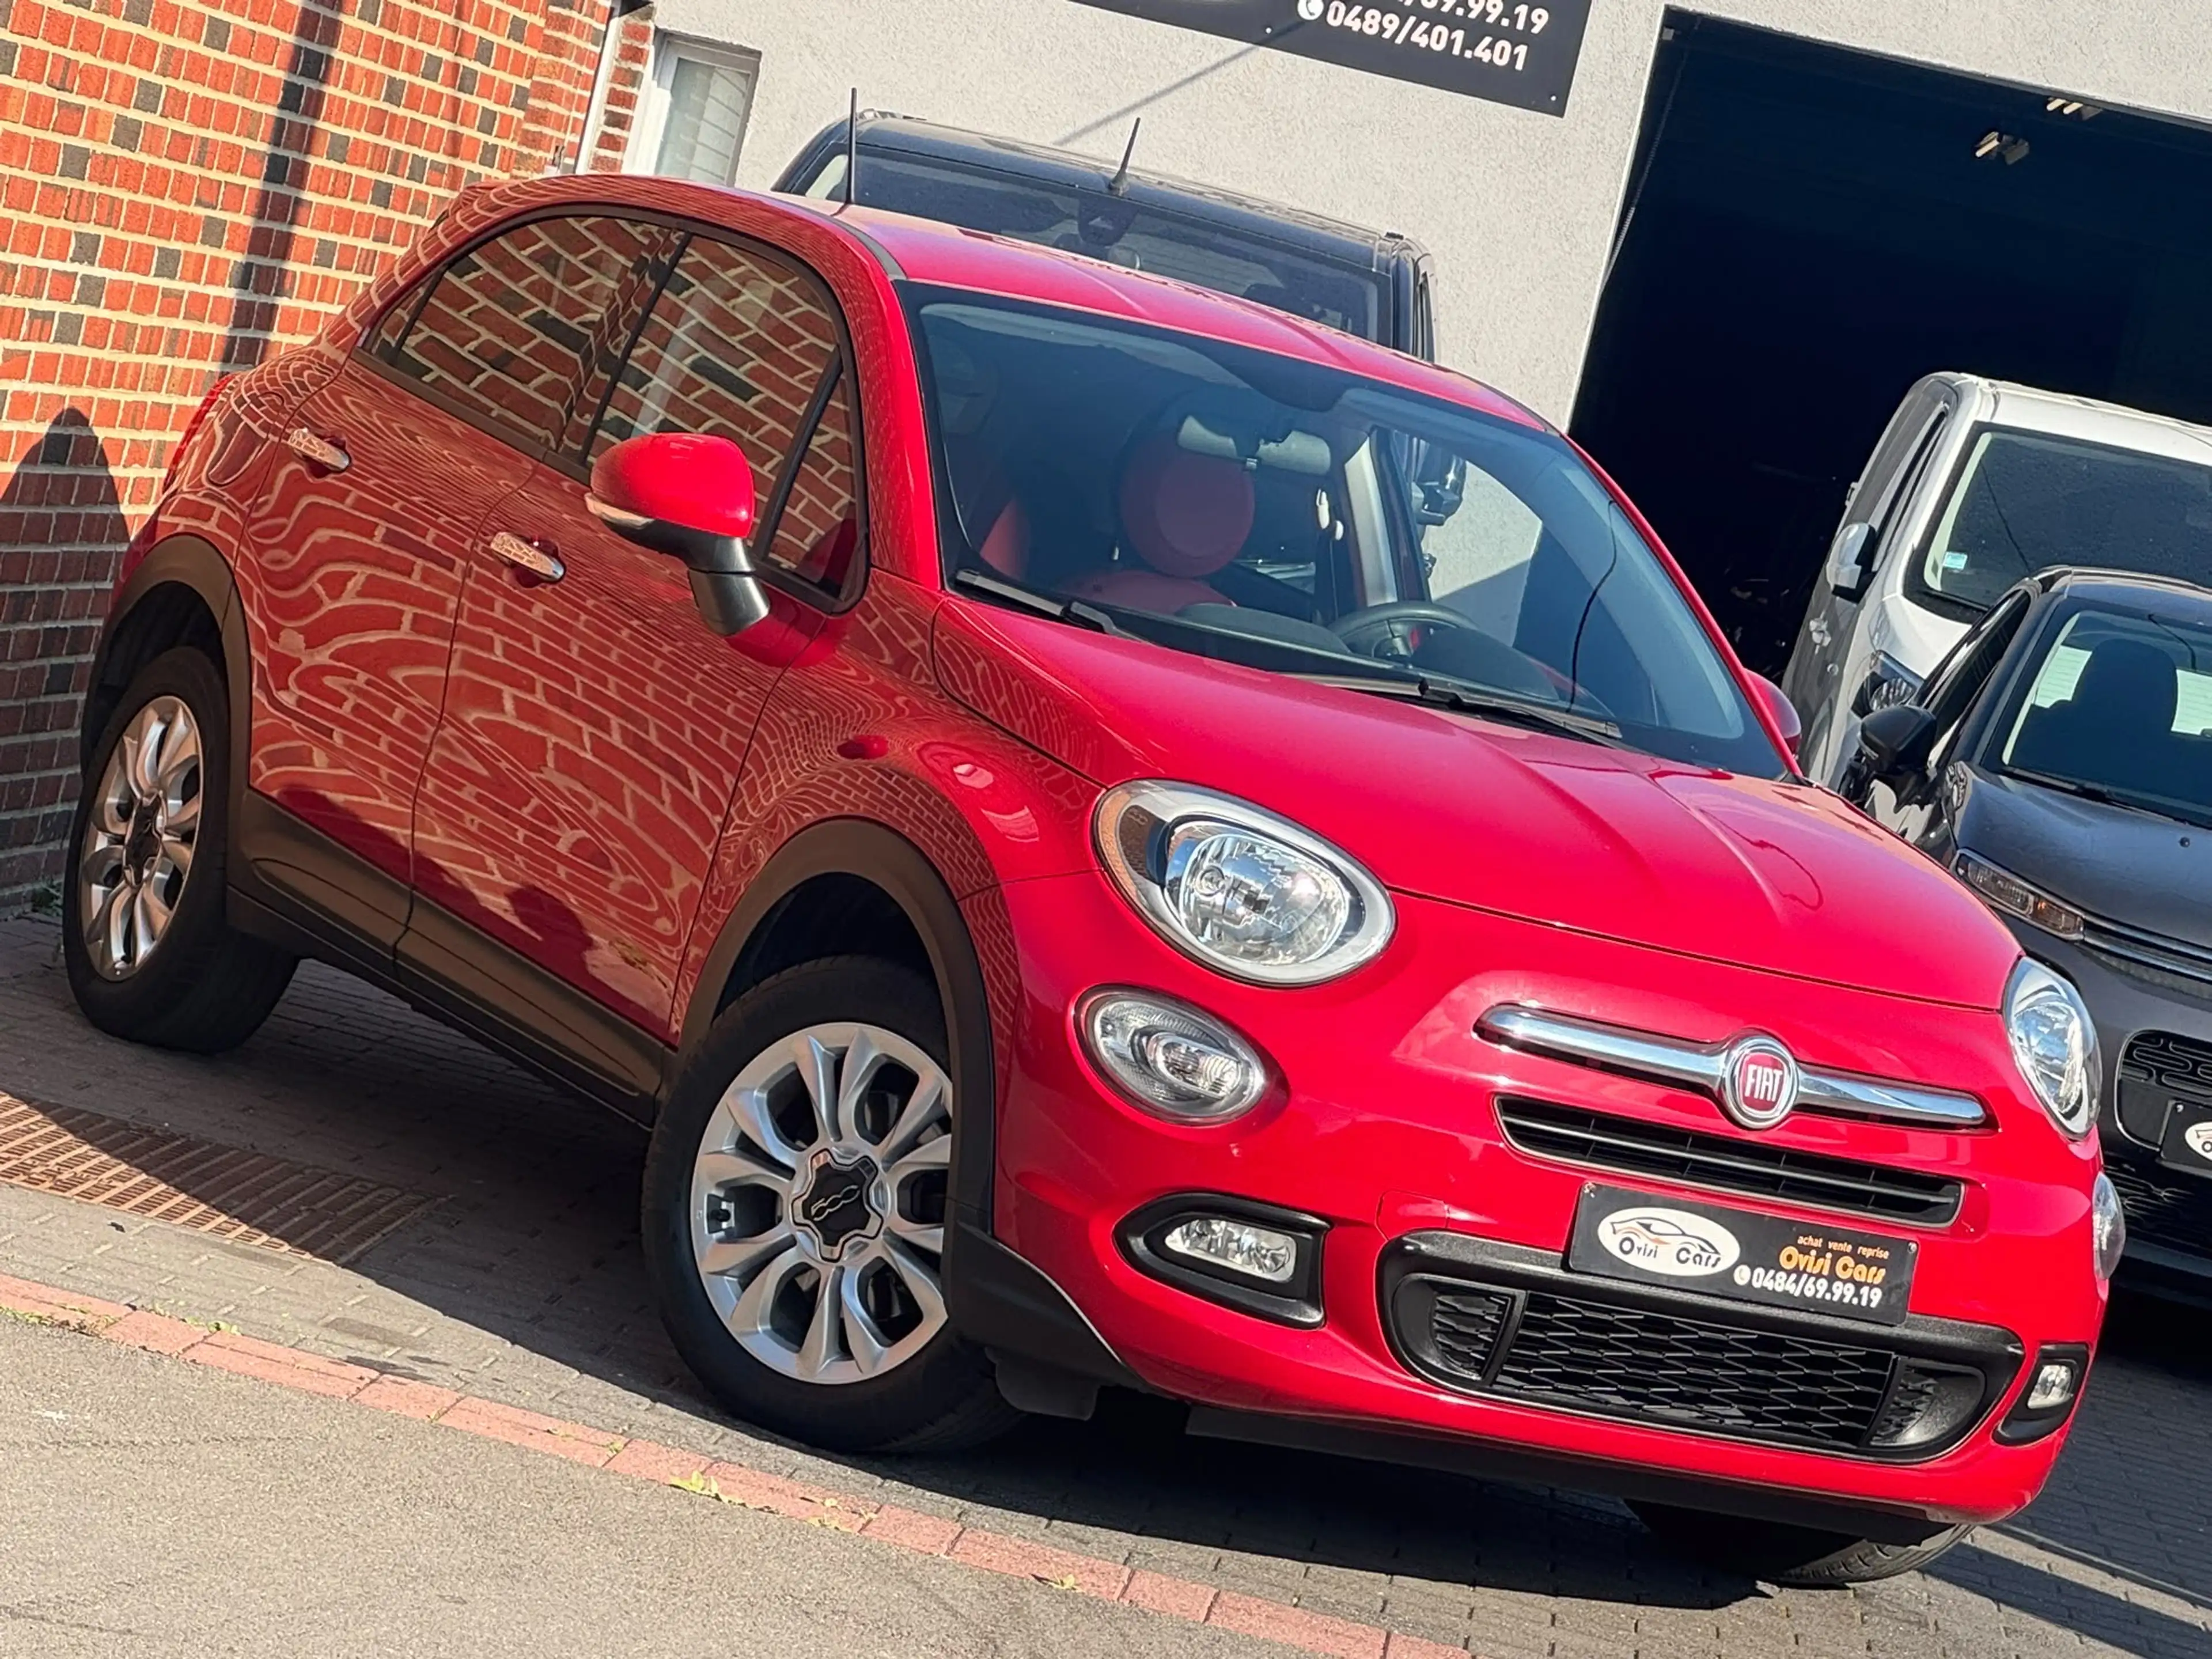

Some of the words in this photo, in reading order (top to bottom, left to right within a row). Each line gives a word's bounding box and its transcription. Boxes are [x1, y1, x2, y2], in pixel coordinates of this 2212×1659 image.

[1325, 1, 1528, 71] 0489/401.401
[1744, 1063, 1783, 1102] FIAT
[810, 1184, 861, 1221] 500
[1619, 1236, 1658, 1259] Ovisi
[1676, 1247, 1722, 1268] Cars
[1779, 1245, 1833, 1276] Ovisi
[1835, 1255, 1887, 1285] Cars
[1797, 1235, 1823, 1249] achat
[1828, 1240, 1853, 1253] vente
[1857, 1245, 1890, 1260] reprise
[1751, 1267, 1883, 1309] 0484/69.99.19
